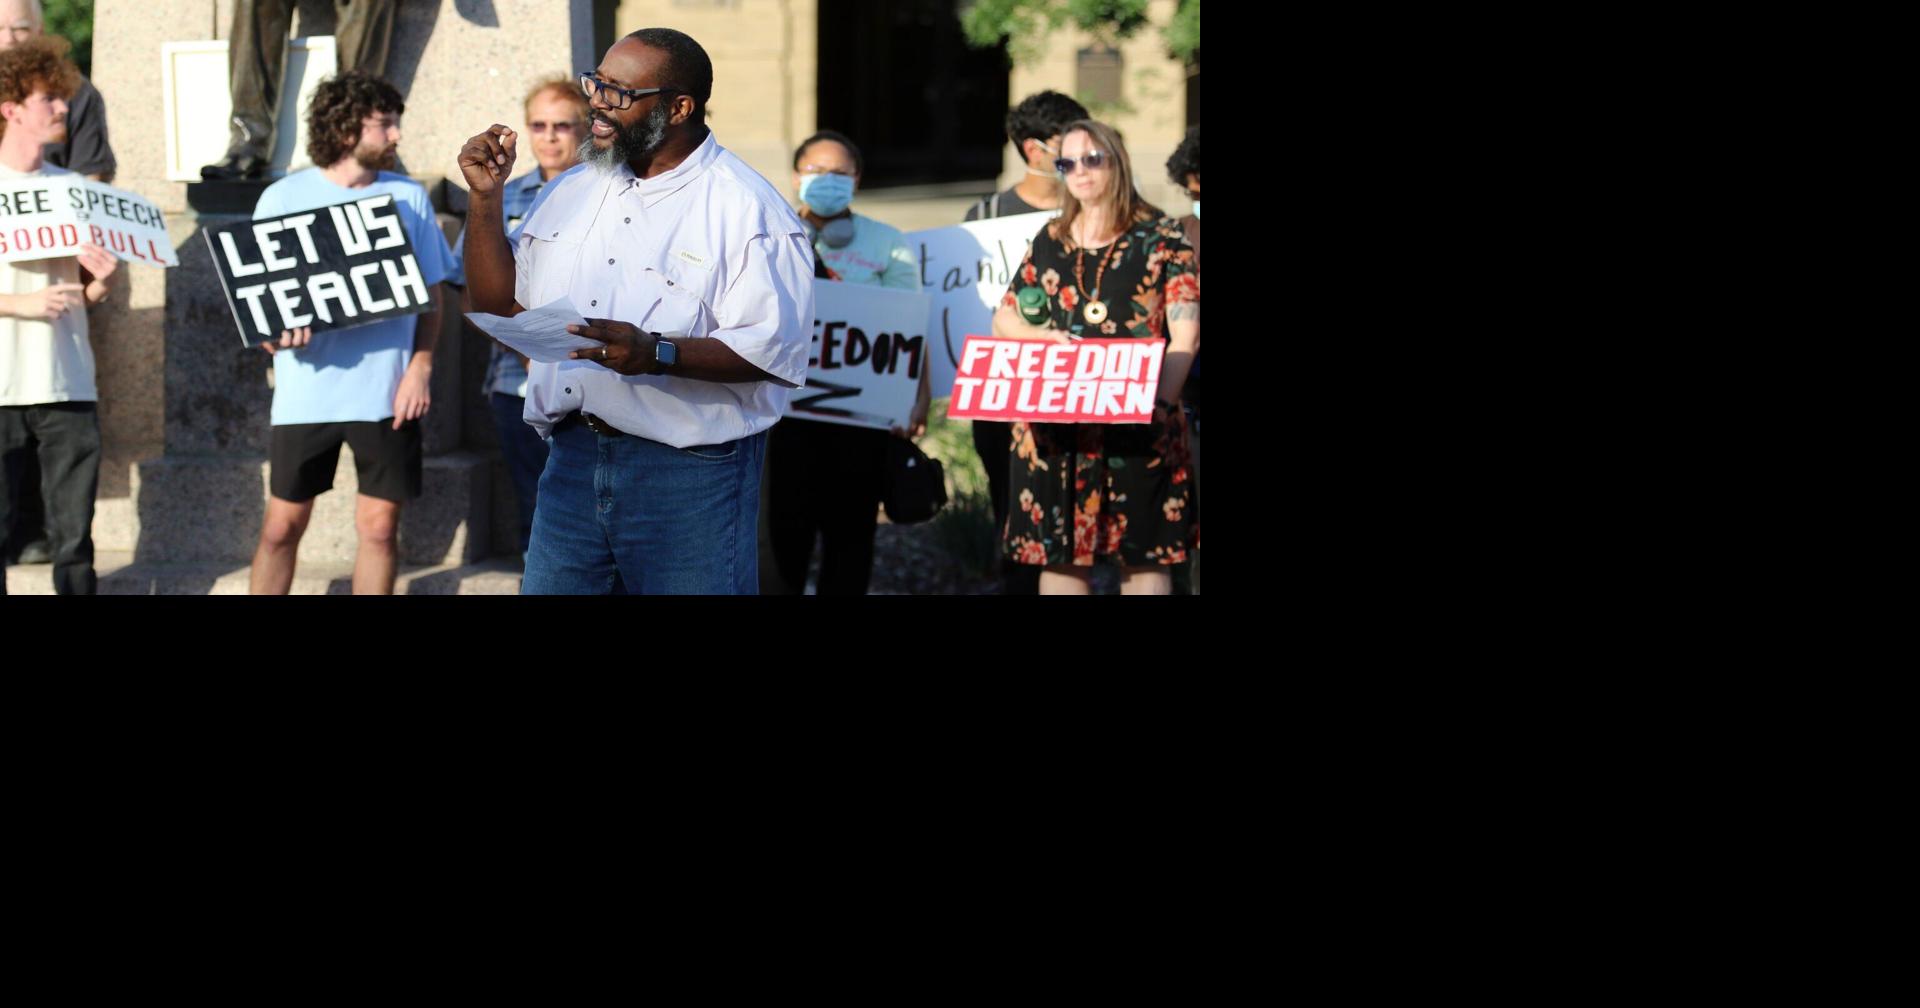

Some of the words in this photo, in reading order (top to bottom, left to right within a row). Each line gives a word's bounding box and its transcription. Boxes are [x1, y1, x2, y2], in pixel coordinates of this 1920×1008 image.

[68, 187, 166, 230] SPEECH
[90, 224, 166, 264] BULL
[218, 213, 320, 278] LET
[329, 194, 405, 256] US
[236, 254, 430, 336] TEACH
[960, 339, 1166, 381] FREEDOM
[954, 378, 1012, 411] TO
[1016, 379, 1159, 416] LEARN
